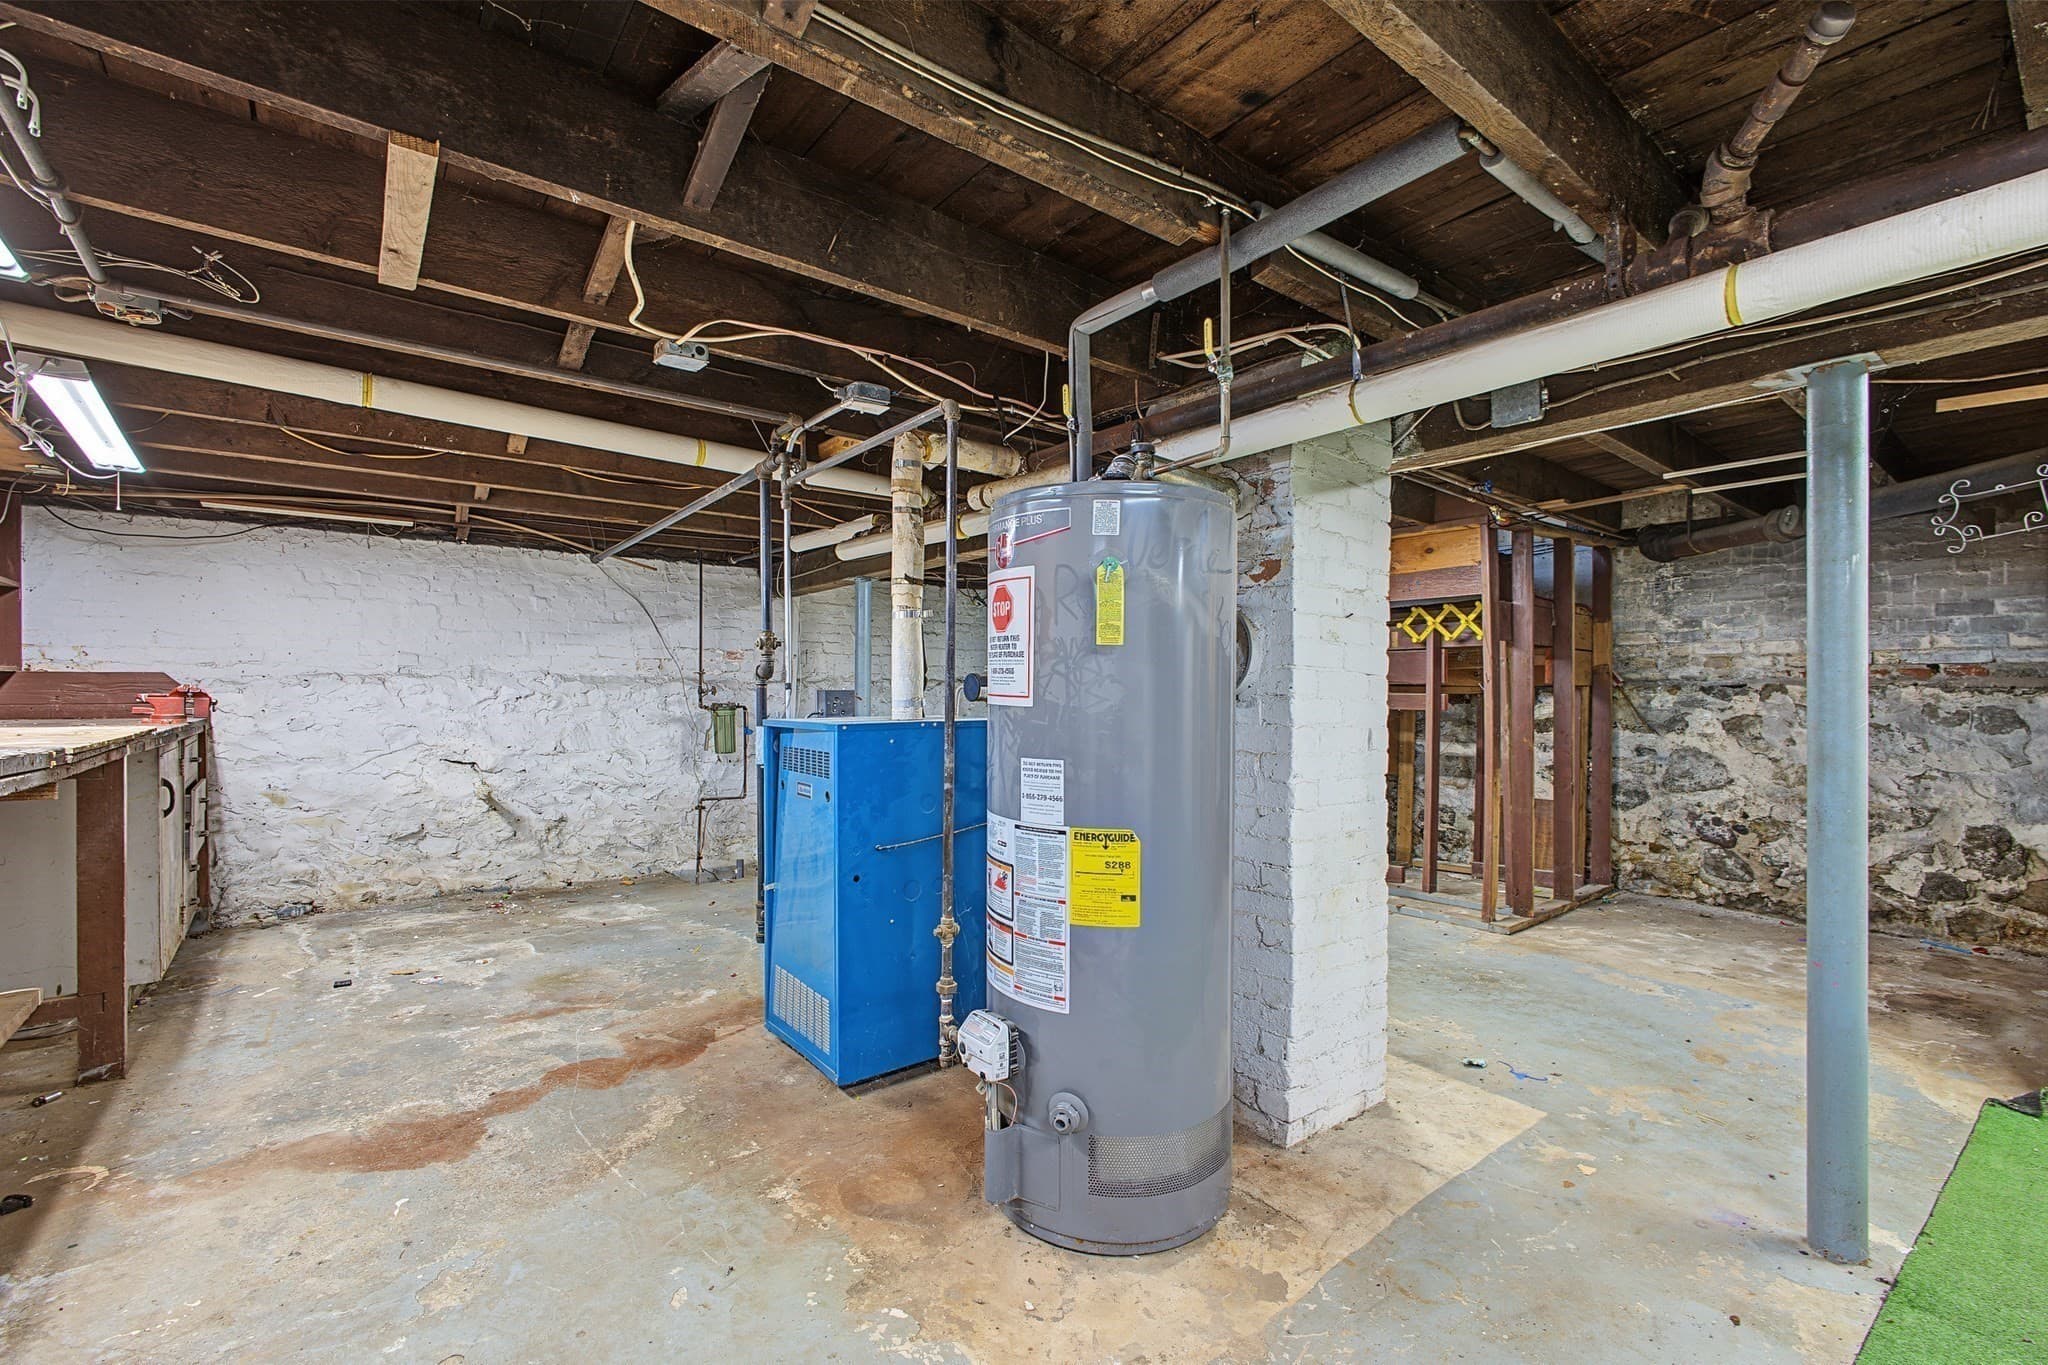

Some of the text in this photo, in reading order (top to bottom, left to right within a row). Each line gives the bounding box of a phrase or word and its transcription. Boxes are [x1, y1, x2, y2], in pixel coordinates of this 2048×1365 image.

[1021, 514, 1043, 527] PLUS
[993, 601, 1011, 617] STOP
[1003, 650, 1025, 658] PURCHASE
[1074, 832, 1136, 842] ENERGYGUIDE
